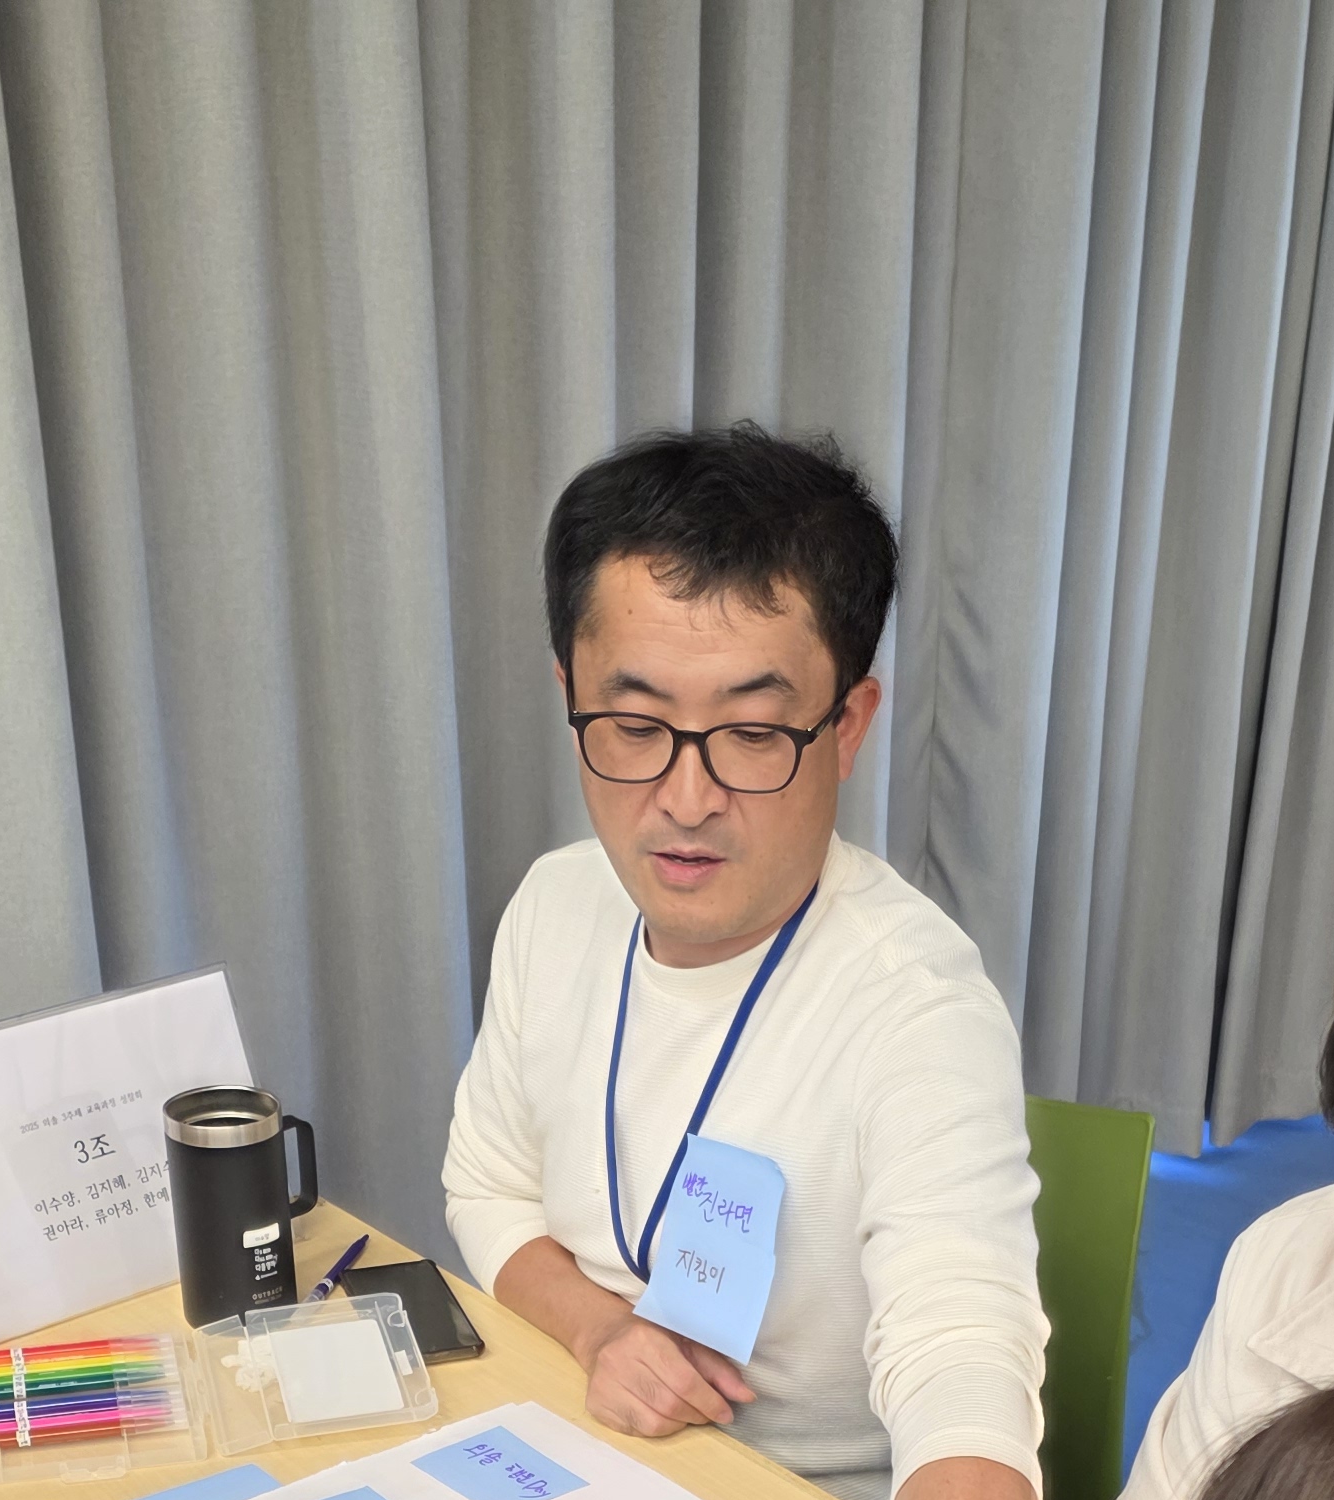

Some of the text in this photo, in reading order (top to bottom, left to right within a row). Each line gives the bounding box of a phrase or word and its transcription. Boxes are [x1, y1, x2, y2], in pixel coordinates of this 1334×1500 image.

[20, 1121, 39, 1134] 2025
[86, 1098, 116, 1114] 교육과정
[74, 1134, 116, 1163] 3조
[676, 1248, 725, 1294] 지킴이
